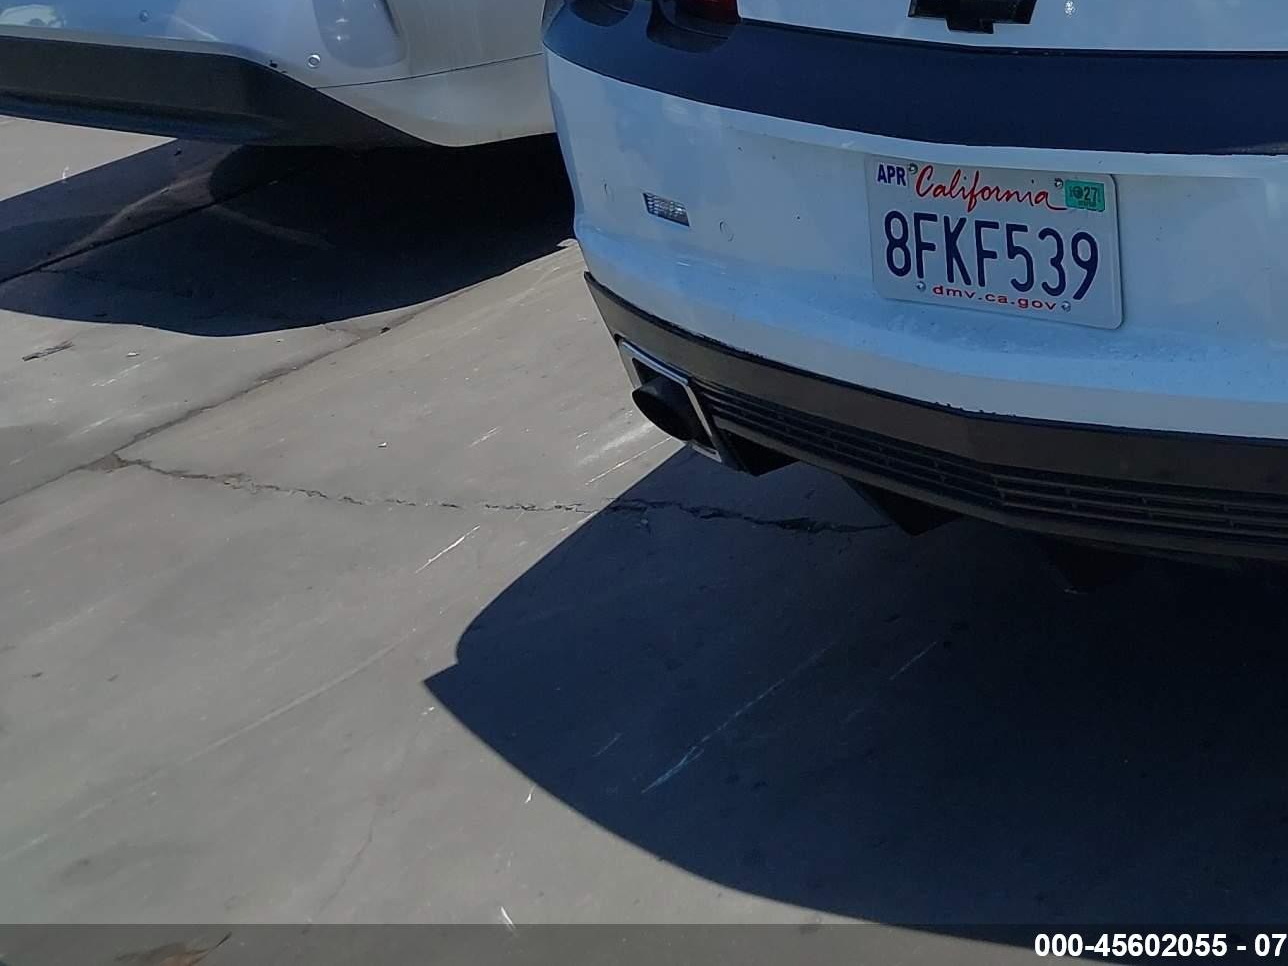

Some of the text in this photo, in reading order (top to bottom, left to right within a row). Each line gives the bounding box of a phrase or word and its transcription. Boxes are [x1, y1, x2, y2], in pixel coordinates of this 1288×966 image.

[877, 163, 907, 187] APR
[915, 164, 1068, 212] California
[884, 210, 1099, 301] 8FKF539
[932, 285, 1058, 311] dmv.ca.gov
